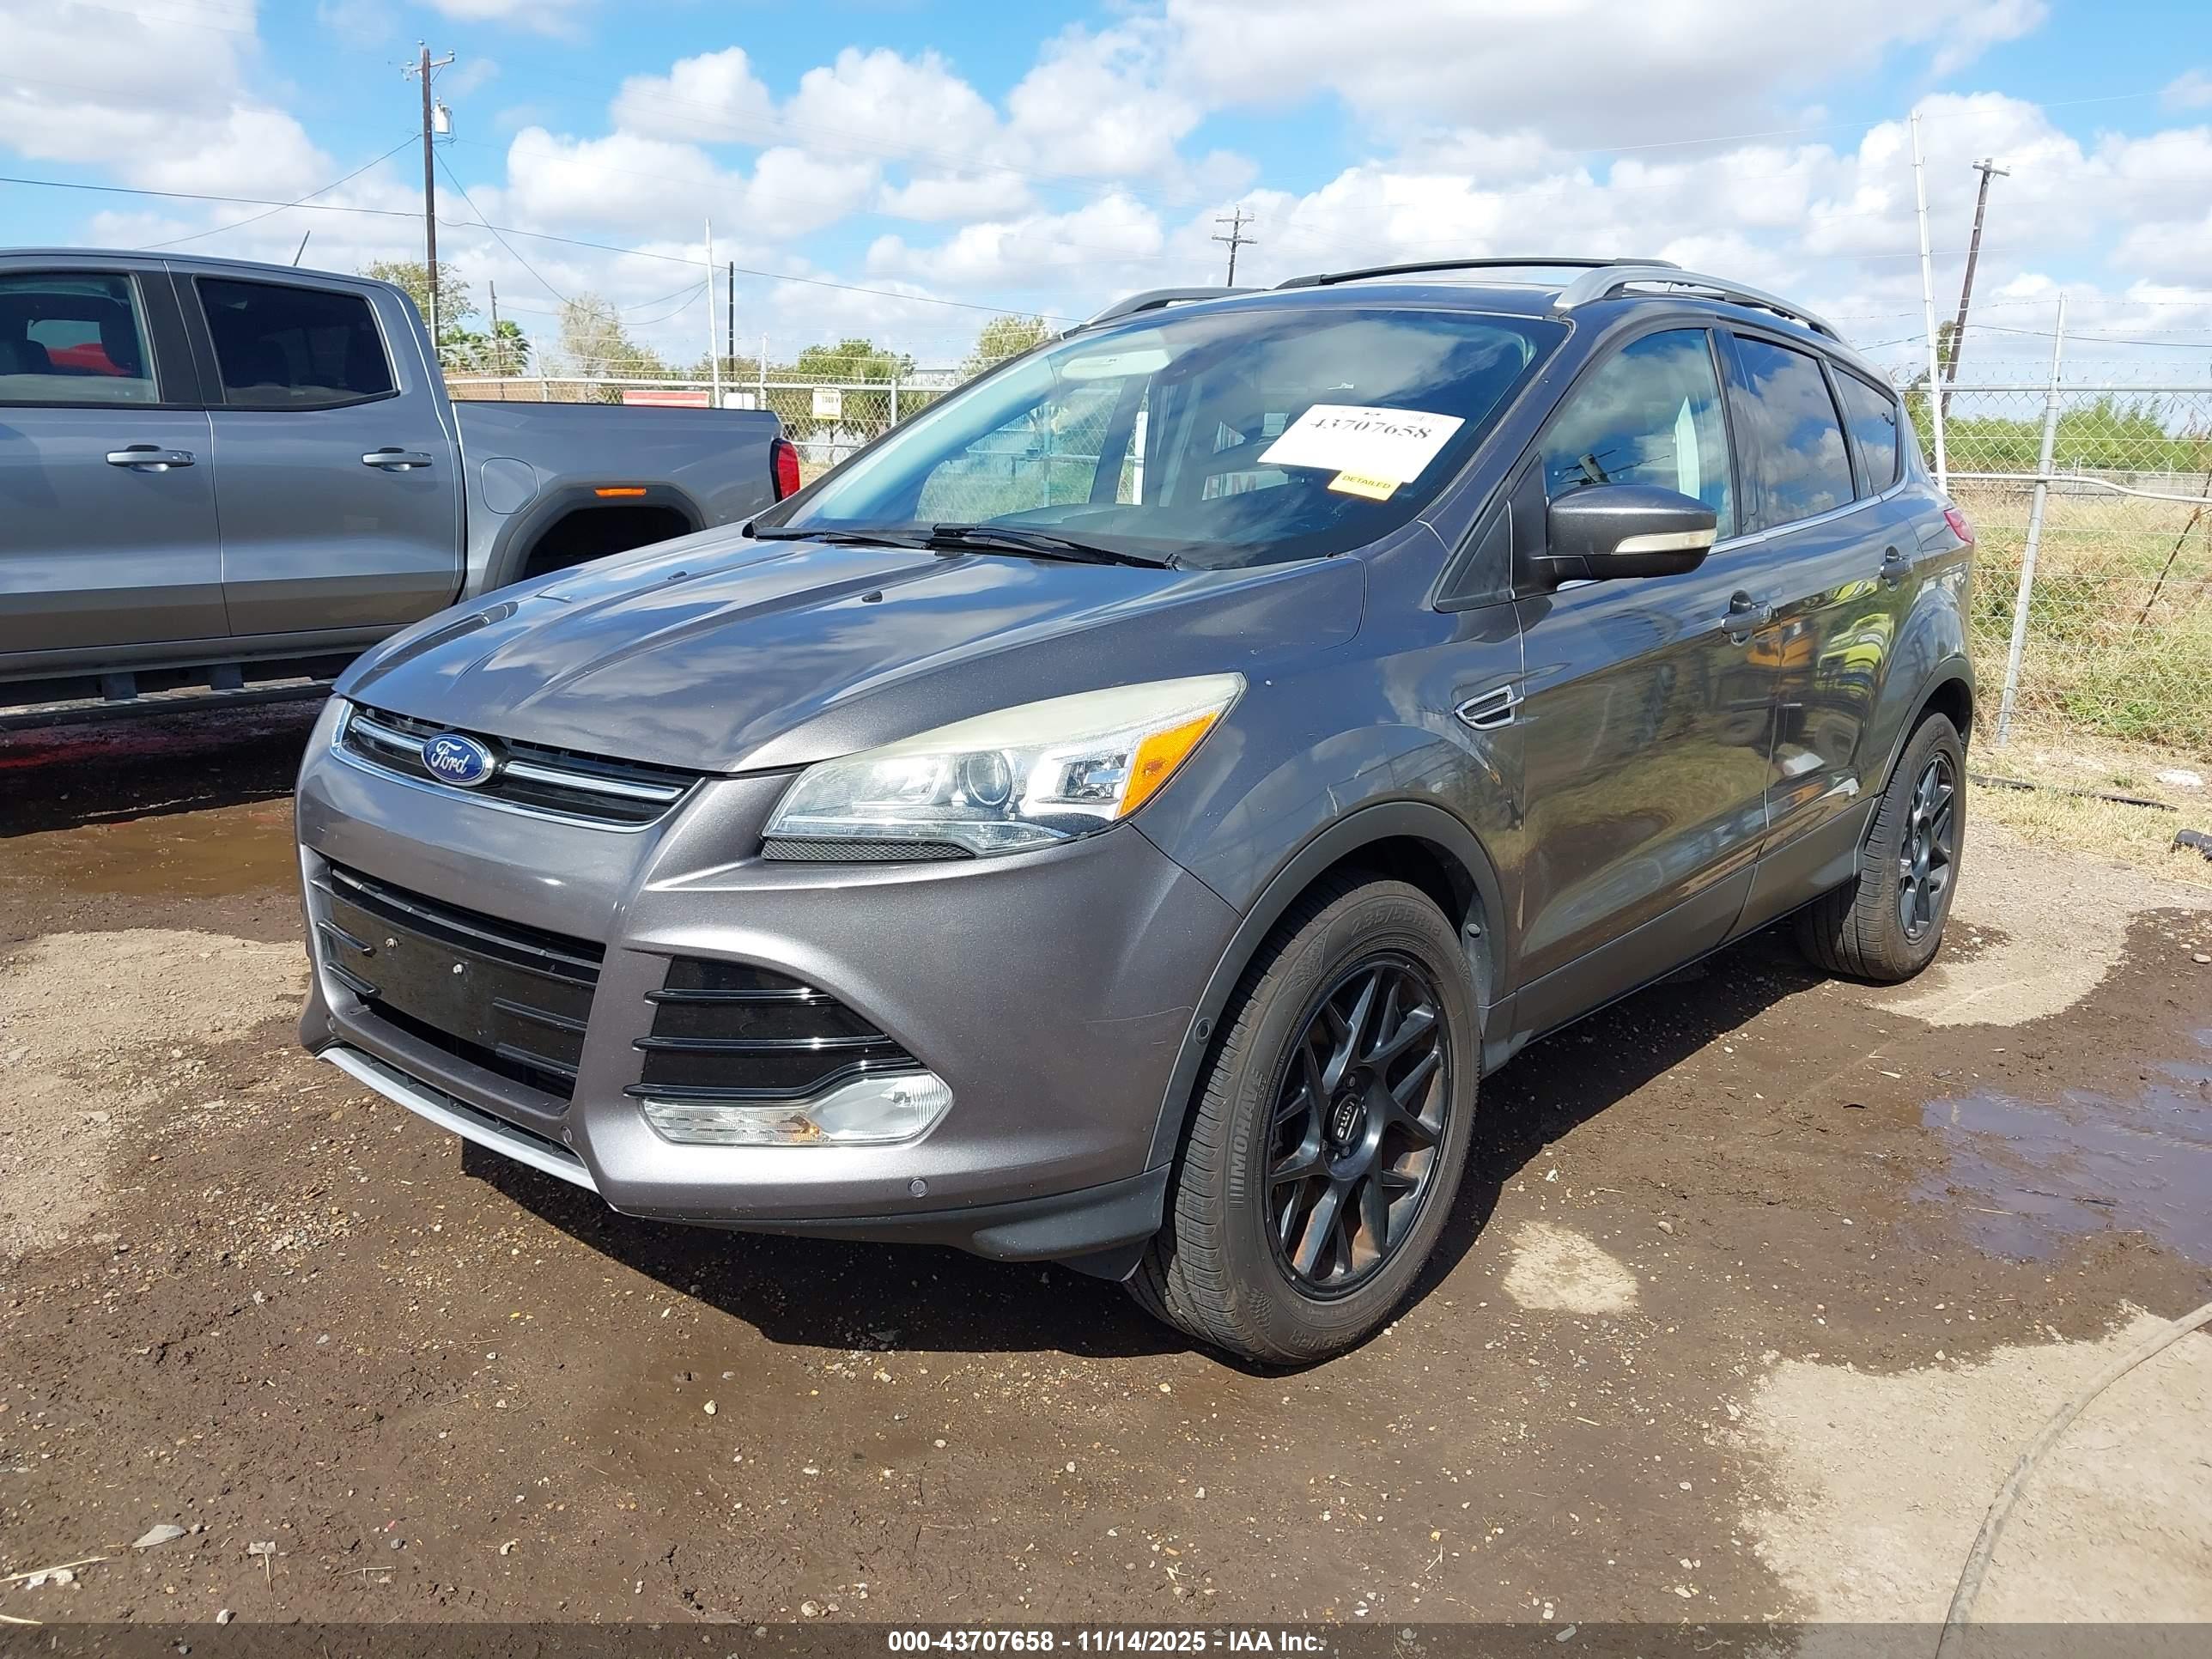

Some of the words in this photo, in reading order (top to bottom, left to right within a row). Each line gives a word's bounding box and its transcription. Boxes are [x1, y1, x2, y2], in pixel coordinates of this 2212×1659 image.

[1310, 418, 1431, 440] 43707658
[1341, 475, 1391, 489] DETAILED
[431, 740, 471, 774] Ford
